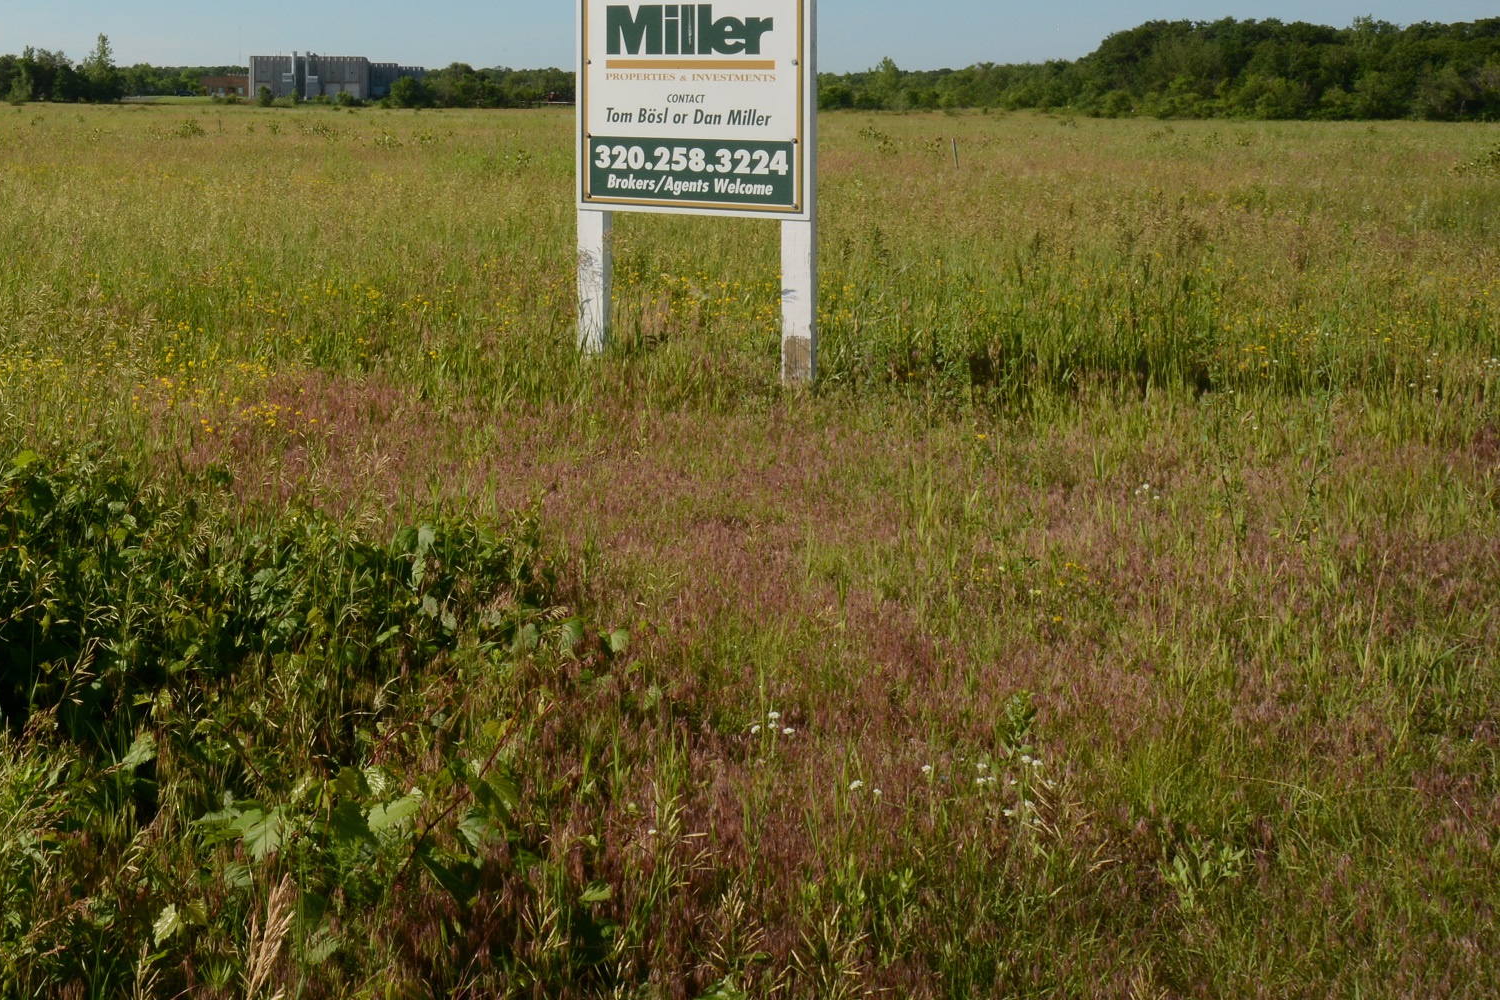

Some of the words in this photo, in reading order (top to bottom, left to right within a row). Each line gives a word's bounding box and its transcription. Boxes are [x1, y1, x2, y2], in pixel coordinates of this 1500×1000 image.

[606, 4, 773, 55] Miller
[606, 73, 675, 81] PROPERTIES
[692, 73, 776, 82] INVESTMENTS
[667, 94, 705, 103] CONTACT
[606, 108, 632, 123] Tom
[638, 108, 668, 124] Bösl
[673, 113, 688, 124] or
[694, 109, 721, 125] Dan
[727, 109, 771, 126] Miller
[595, 145, 788, 175] 320.258.3224
[607, 174, 709, 194] Brokers/Agents
[714, 178, 773, 195] Welcome
